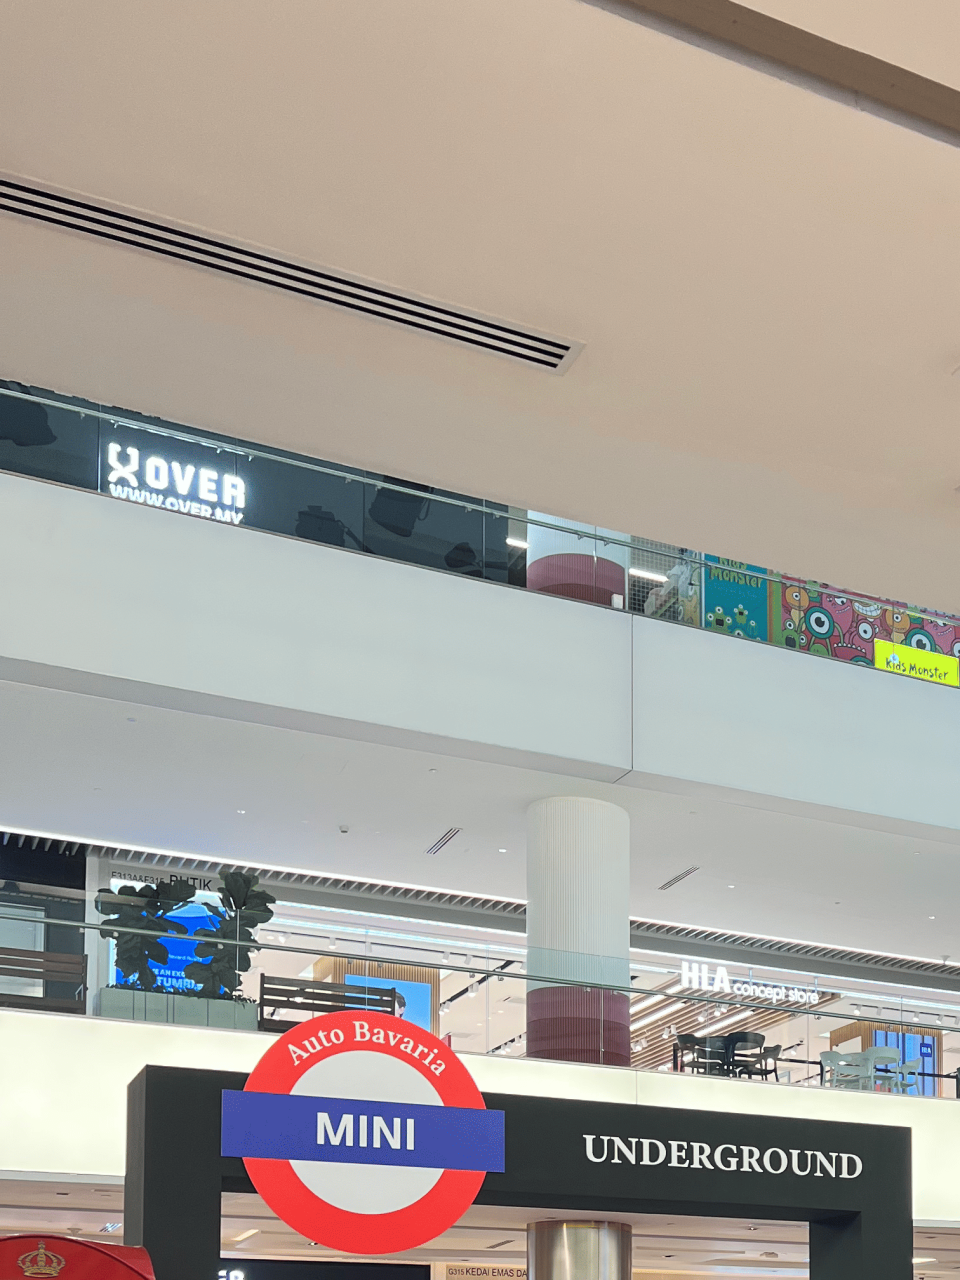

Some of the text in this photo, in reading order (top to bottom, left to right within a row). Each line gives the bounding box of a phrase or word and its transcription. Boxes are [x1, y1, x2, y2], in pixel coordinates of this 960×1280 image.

[708, 567, 763, 588] Monster
[908, 662, 949, 681] Monster
[681, 960, 820, 1005] HLA concept store
[286, 1021, 447, 1078] Auto Bavaria
[316, 1111, 416, 1152] MINI
[582, 1133, 864, 1180] UNDERGROUND
[465, 1267, 490, 1277] KEDAI
[491, 1268, 515, 1278] EMAS
